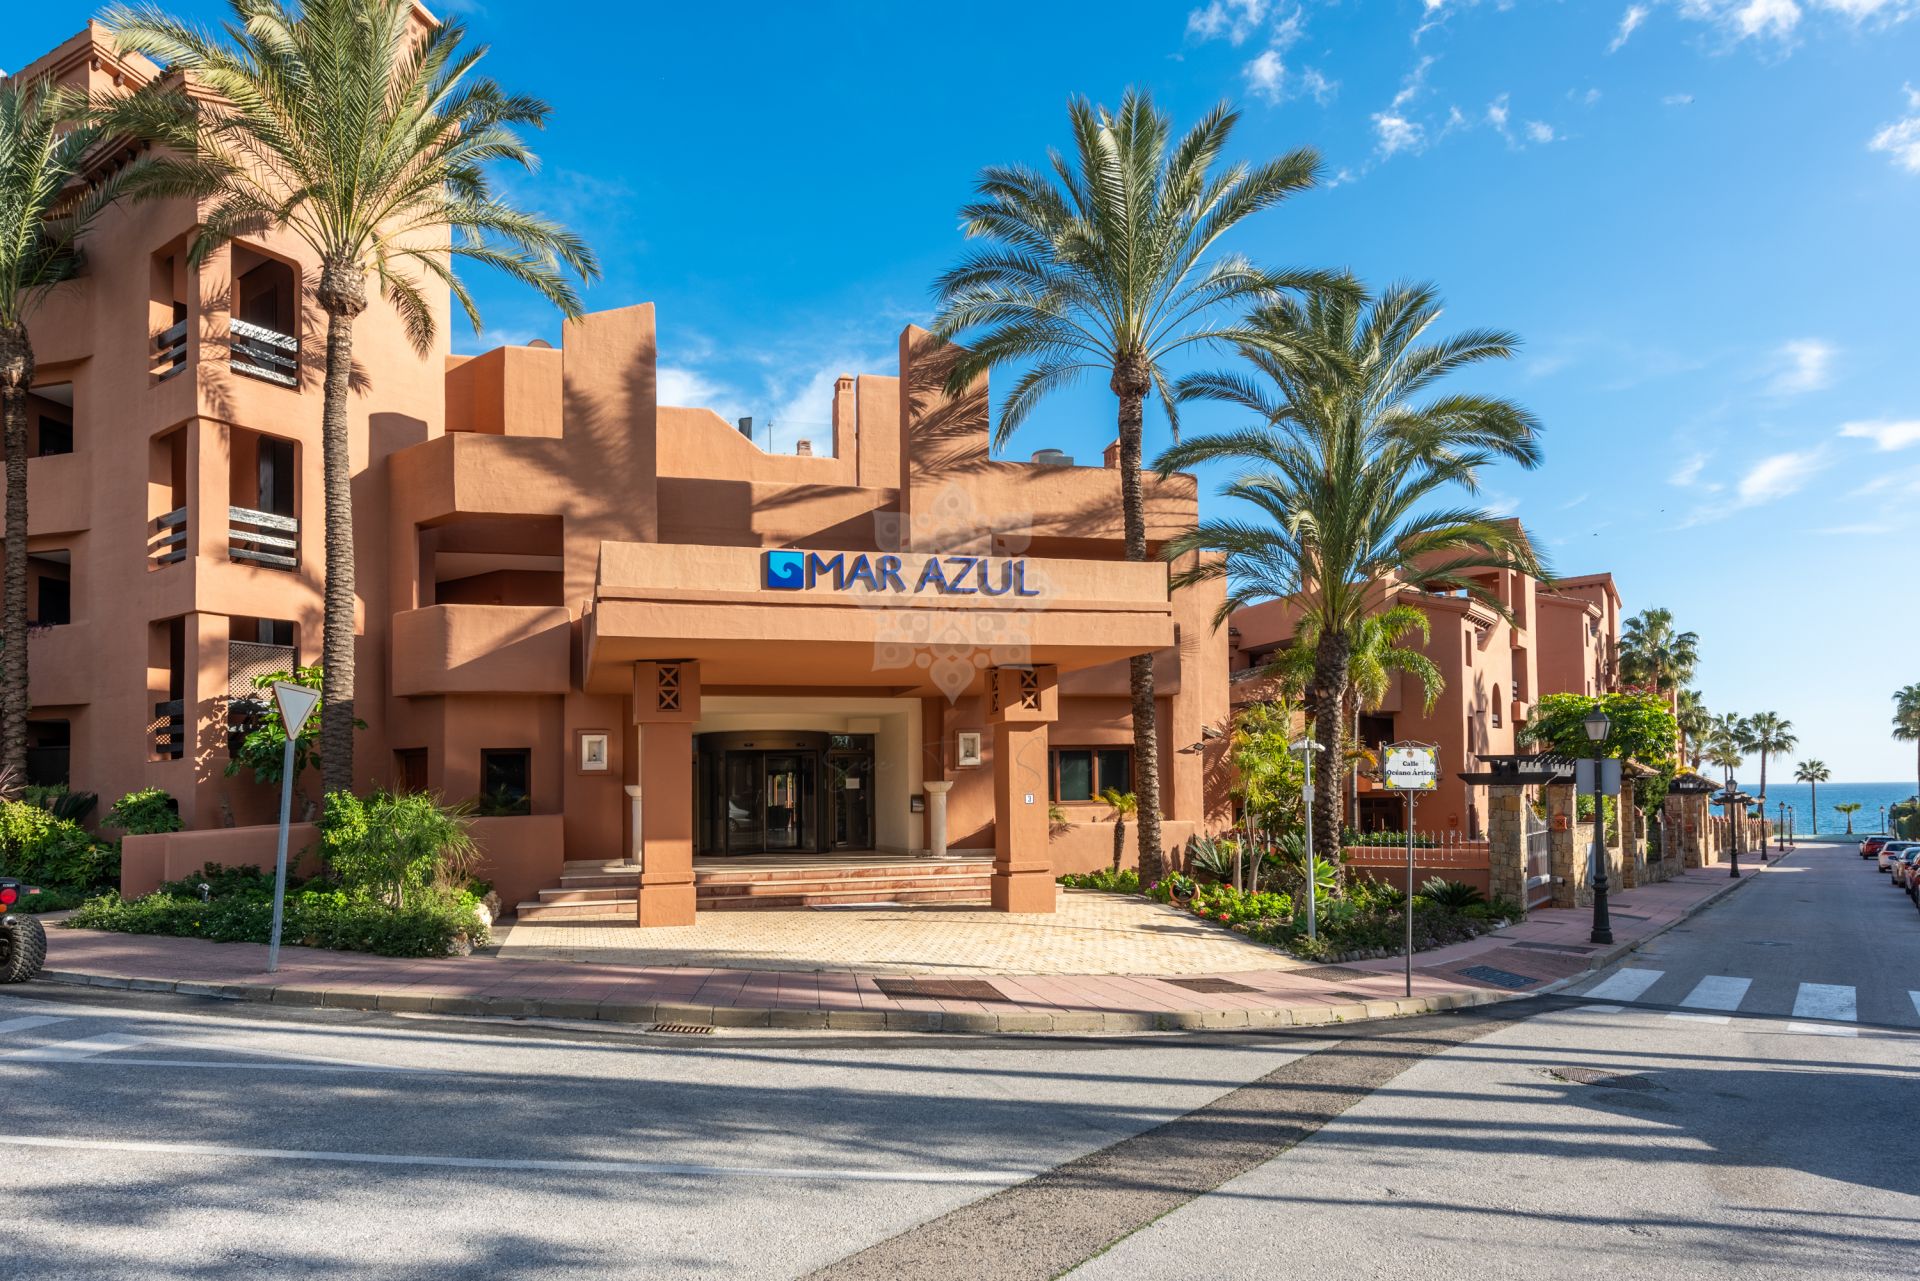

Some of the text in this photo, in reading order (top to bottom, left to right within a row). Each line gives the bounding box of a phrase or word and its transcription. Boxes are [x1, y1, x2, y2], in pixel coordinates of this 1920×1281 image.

[810, 551, 1040, 596] MAR AZUL
[1412, 768, 1434, 776] Ártico
